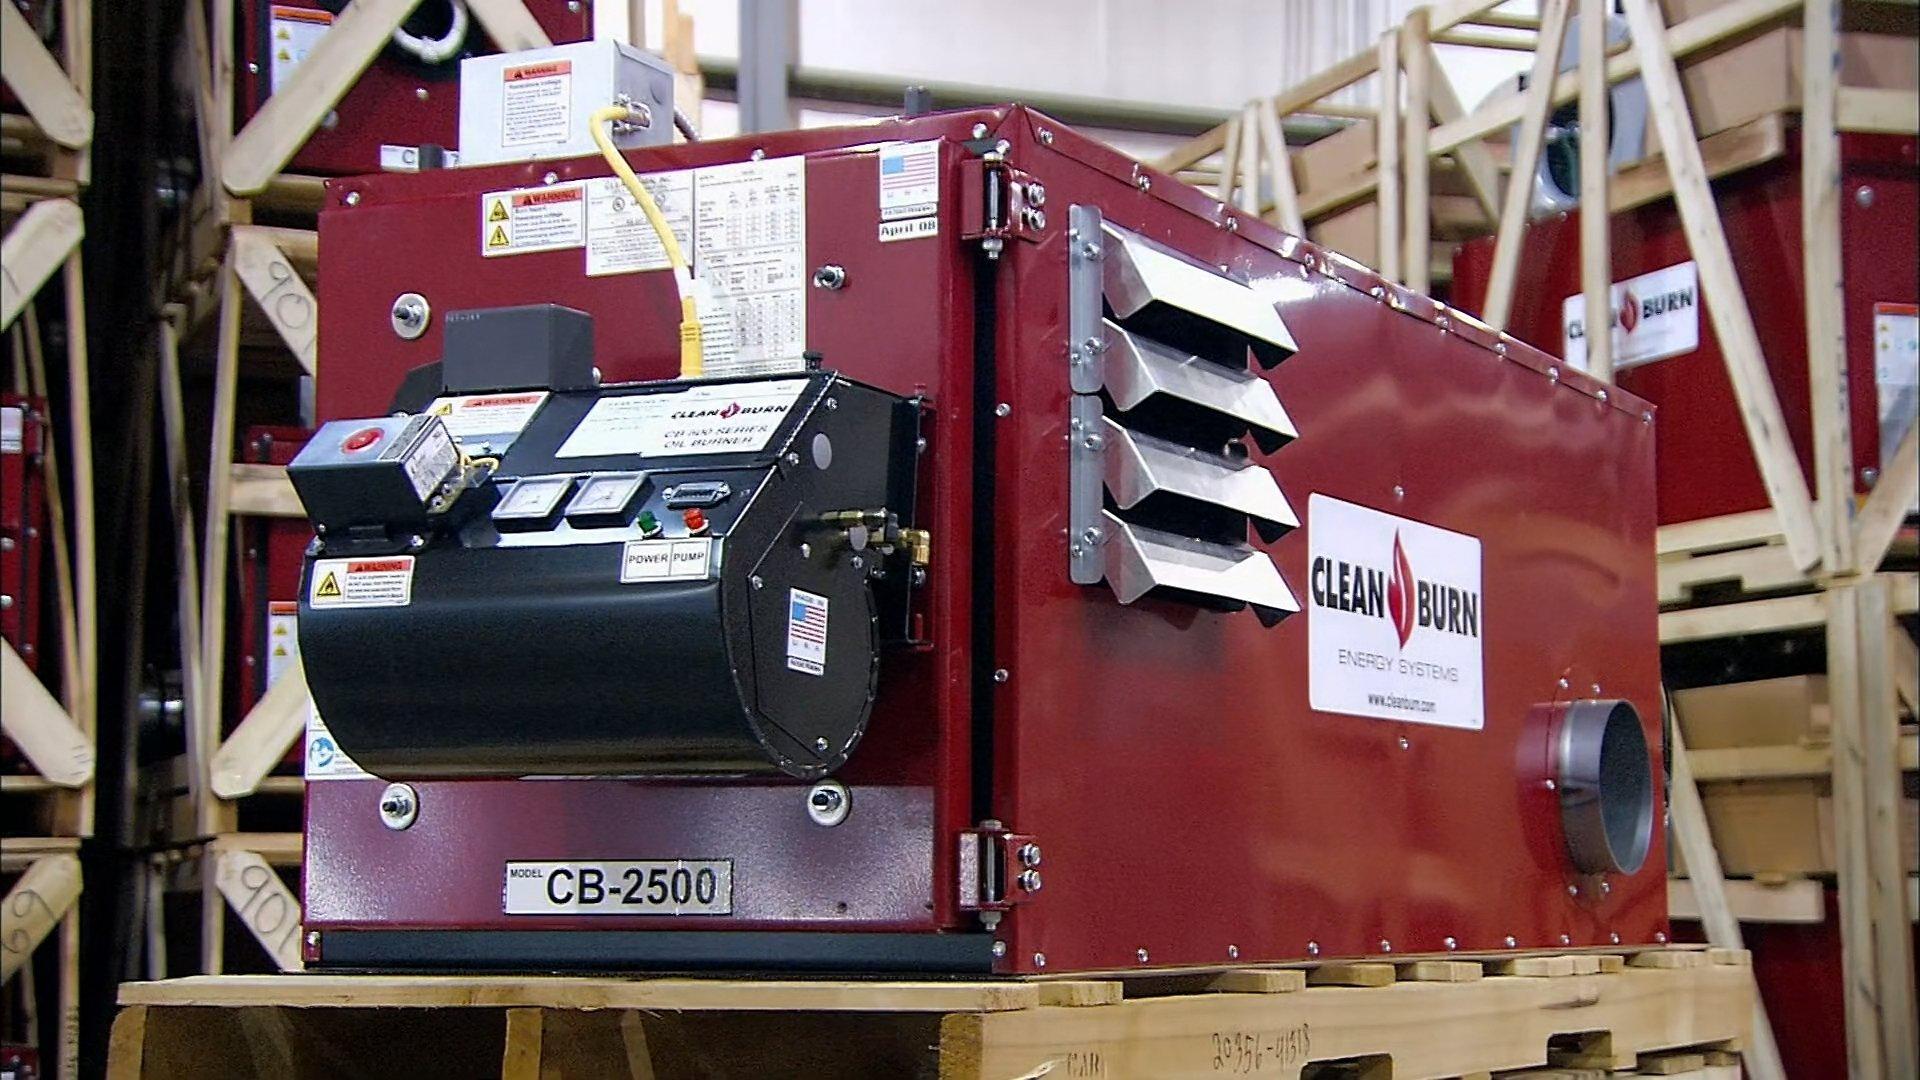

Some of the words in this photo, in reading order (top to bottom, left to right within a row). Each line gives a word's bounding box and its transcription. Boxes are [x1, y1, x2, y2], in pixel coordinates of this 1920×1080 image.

[532, 189, 576, 202] WARNING
[881, 223, 913, 236] April
[919, 220, 936, 231] 08
[1642, 287, 1692, 319] BURN
[671, 409, 720, 419] CLEAN
[741, 404, 788, 414] BURN
[628, 553, 669, 565] POWER
[673, 551, 705, 563] PUMP
[1311, 555, 1385, 618] CLEAN
[1418, 580, 1478, 637] BURN
[1338, 648, 1394, 672] ENERGY
[1400, 658, 1459, 683] SYSTEMS
[1368, 692, 1437, 713] www.cleanburn.com
[510, 868, 543, 879] MODEL
[546, 867, 717, 905] CB-2500
